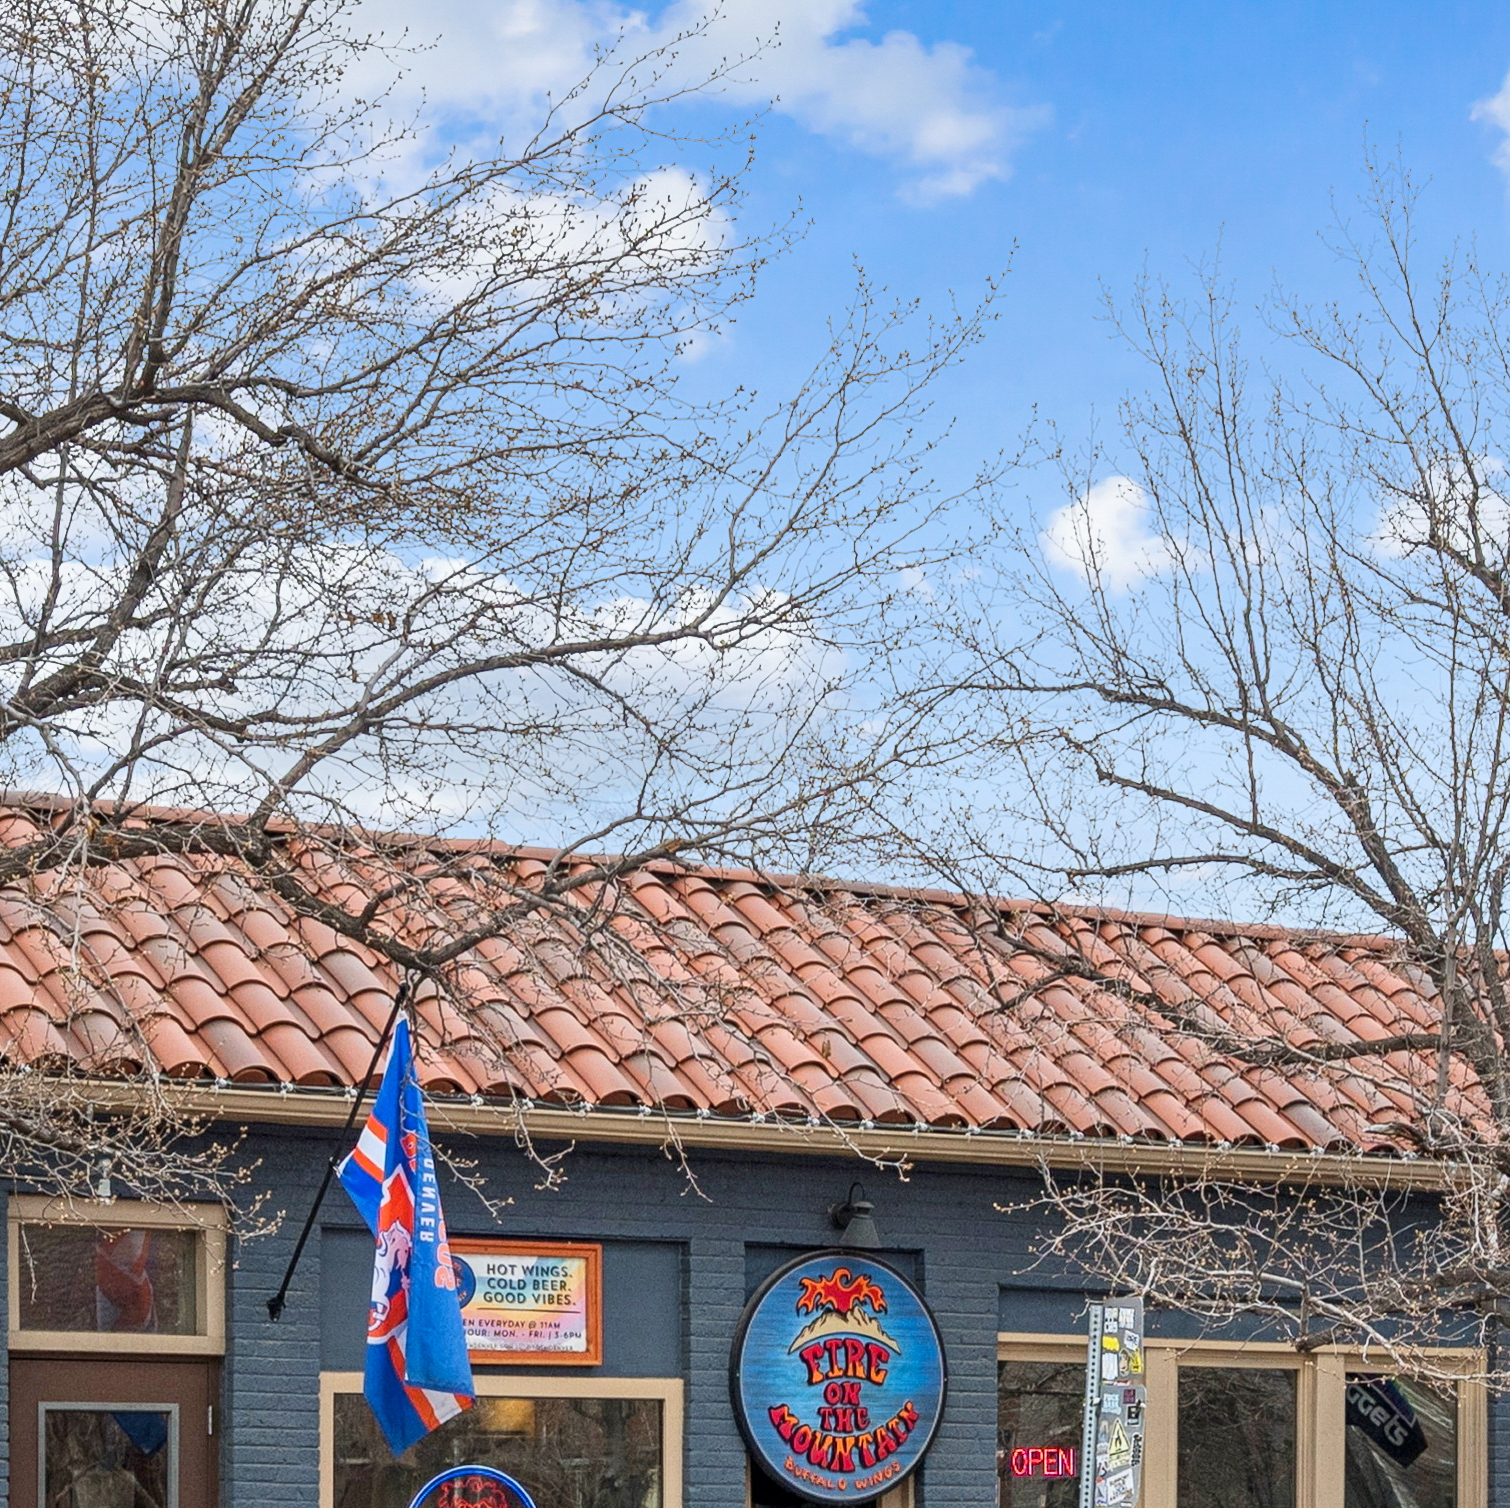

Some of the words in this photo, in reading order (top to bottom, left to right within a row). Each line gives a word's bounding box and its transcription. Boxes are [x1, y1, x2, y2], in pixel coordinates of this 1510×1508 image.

[486, 1263, 517, 1276] HOT
[521, 1265, 574, 1279] WINGS.
[486, 1277, 527, 1291] COLD
[532, 1279, 573, 1292] BEER.
[483, 1291, 526, 1304] GOOD
[532, 1293, 577, 1306] VIBES.
[462, 1319, 474, 1327] EN
[478, 1319, 526, 1329] EVERYDAY
[528, 1320, 536, 1329] @
[540, 1321, 561, 1329] 11AM
[493, 1329, 518, 1338] MON.
[529, 1330, 546, 1338] FRI.
[554, 1331, 582, 1339] 3-6PM
[799, 1337, 891, 1386] FIRE
[823, 1381, 862, 1406] ON
[817, 1406, 871, 1433] THE
[767, 1400, 921, 1473] MOUNTAIN
[784, 1456, 848, 1491] BUFFALO
[854, 1460, 901, 1491] WINGS
[1011, 1447, 1076, 1477] OPEN
